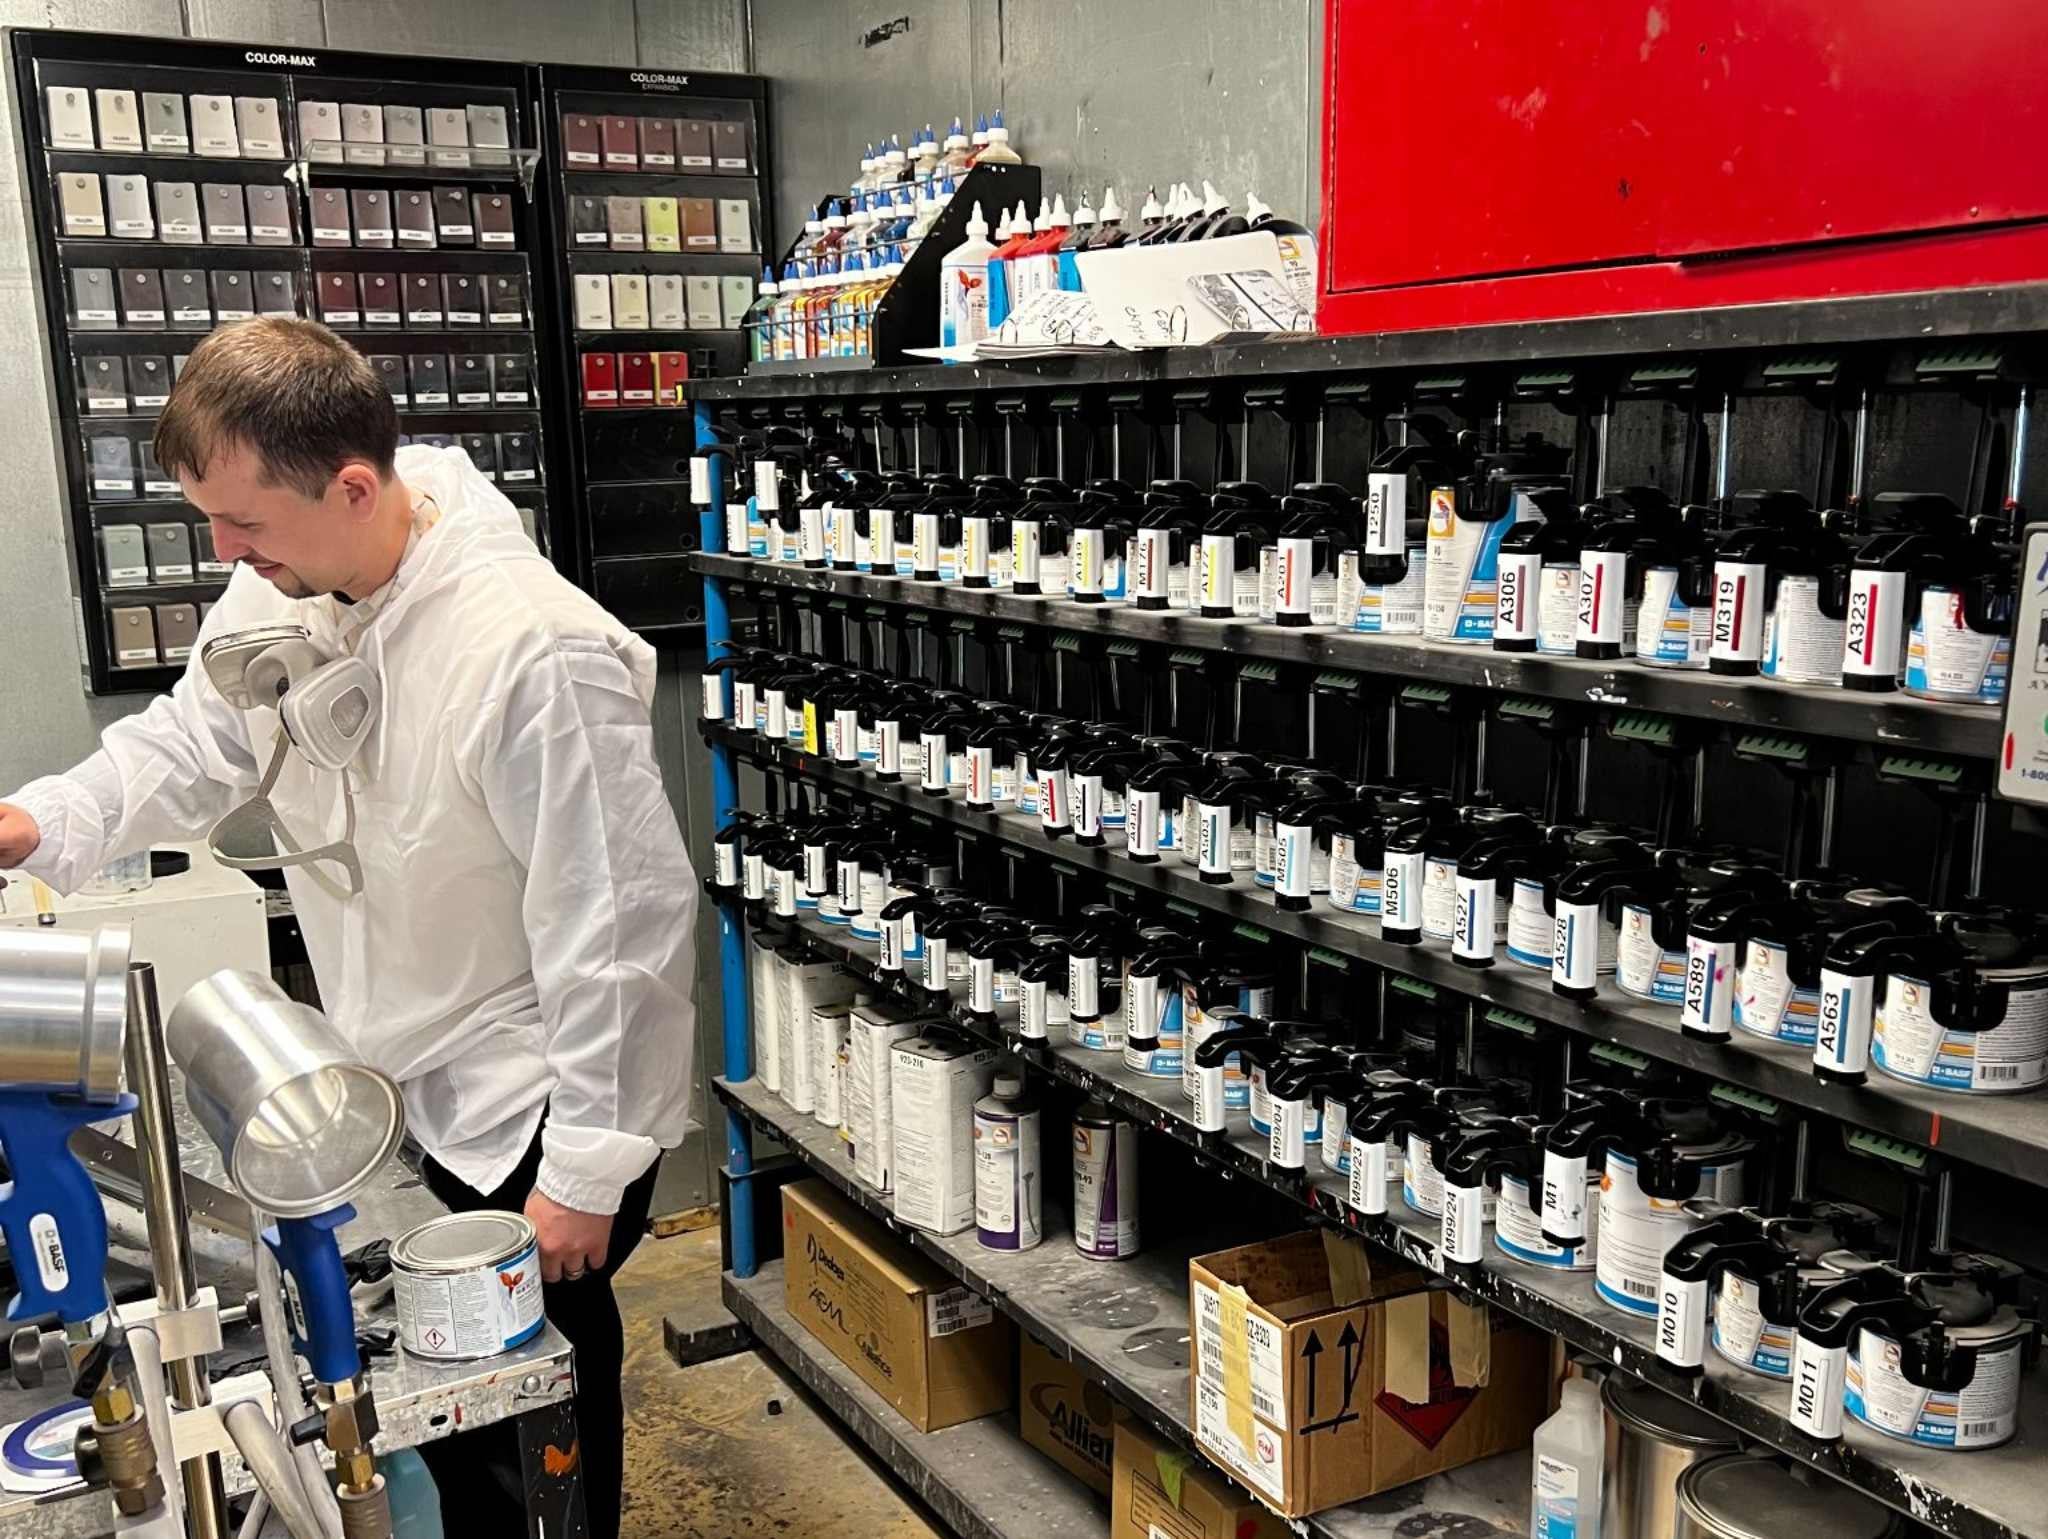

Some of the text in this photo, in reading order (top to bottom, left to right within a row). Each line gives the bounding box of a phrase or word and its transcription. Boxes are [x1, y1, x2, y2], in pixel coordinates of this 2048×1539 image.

[245, 51, 316, 67] COLOR-MAX
[630, 72, 689, 85] COLOR-MAX
[1369, 492, 1380, 536] 1250
[1202, 551, 1210, 593] A177
[1277, 556, 1287, 599] A201
[1579, 570, 1595, 625] A307
[1500, 572, 1516, 624] A306
[1715, 581, 1735, 642] M319
[1848, 592, 1867, 654] A323
[1277, 838, 1288, 882] M505
[1385, 867, 1398, 916] M506
[1455, 892, 1468, 942] A527
[1554, 918, 1567, 969] A528
[1687, 957, 1705, 1013] A589
[1820, 992, 1839, 1052] A563
[1273, 1103, 1282, 1160] M99/04
[1352, 1146, 1362, 1206] M99/23
[1545, 1181, 1557, 1209] M1
[1446, 1191, 1457, 1254] M99/24
[49, 1243, 65, 1273] BASF
[1662, 1292, 1678, 1349] M010
[1798, 1360, 1817, 1419] M011
